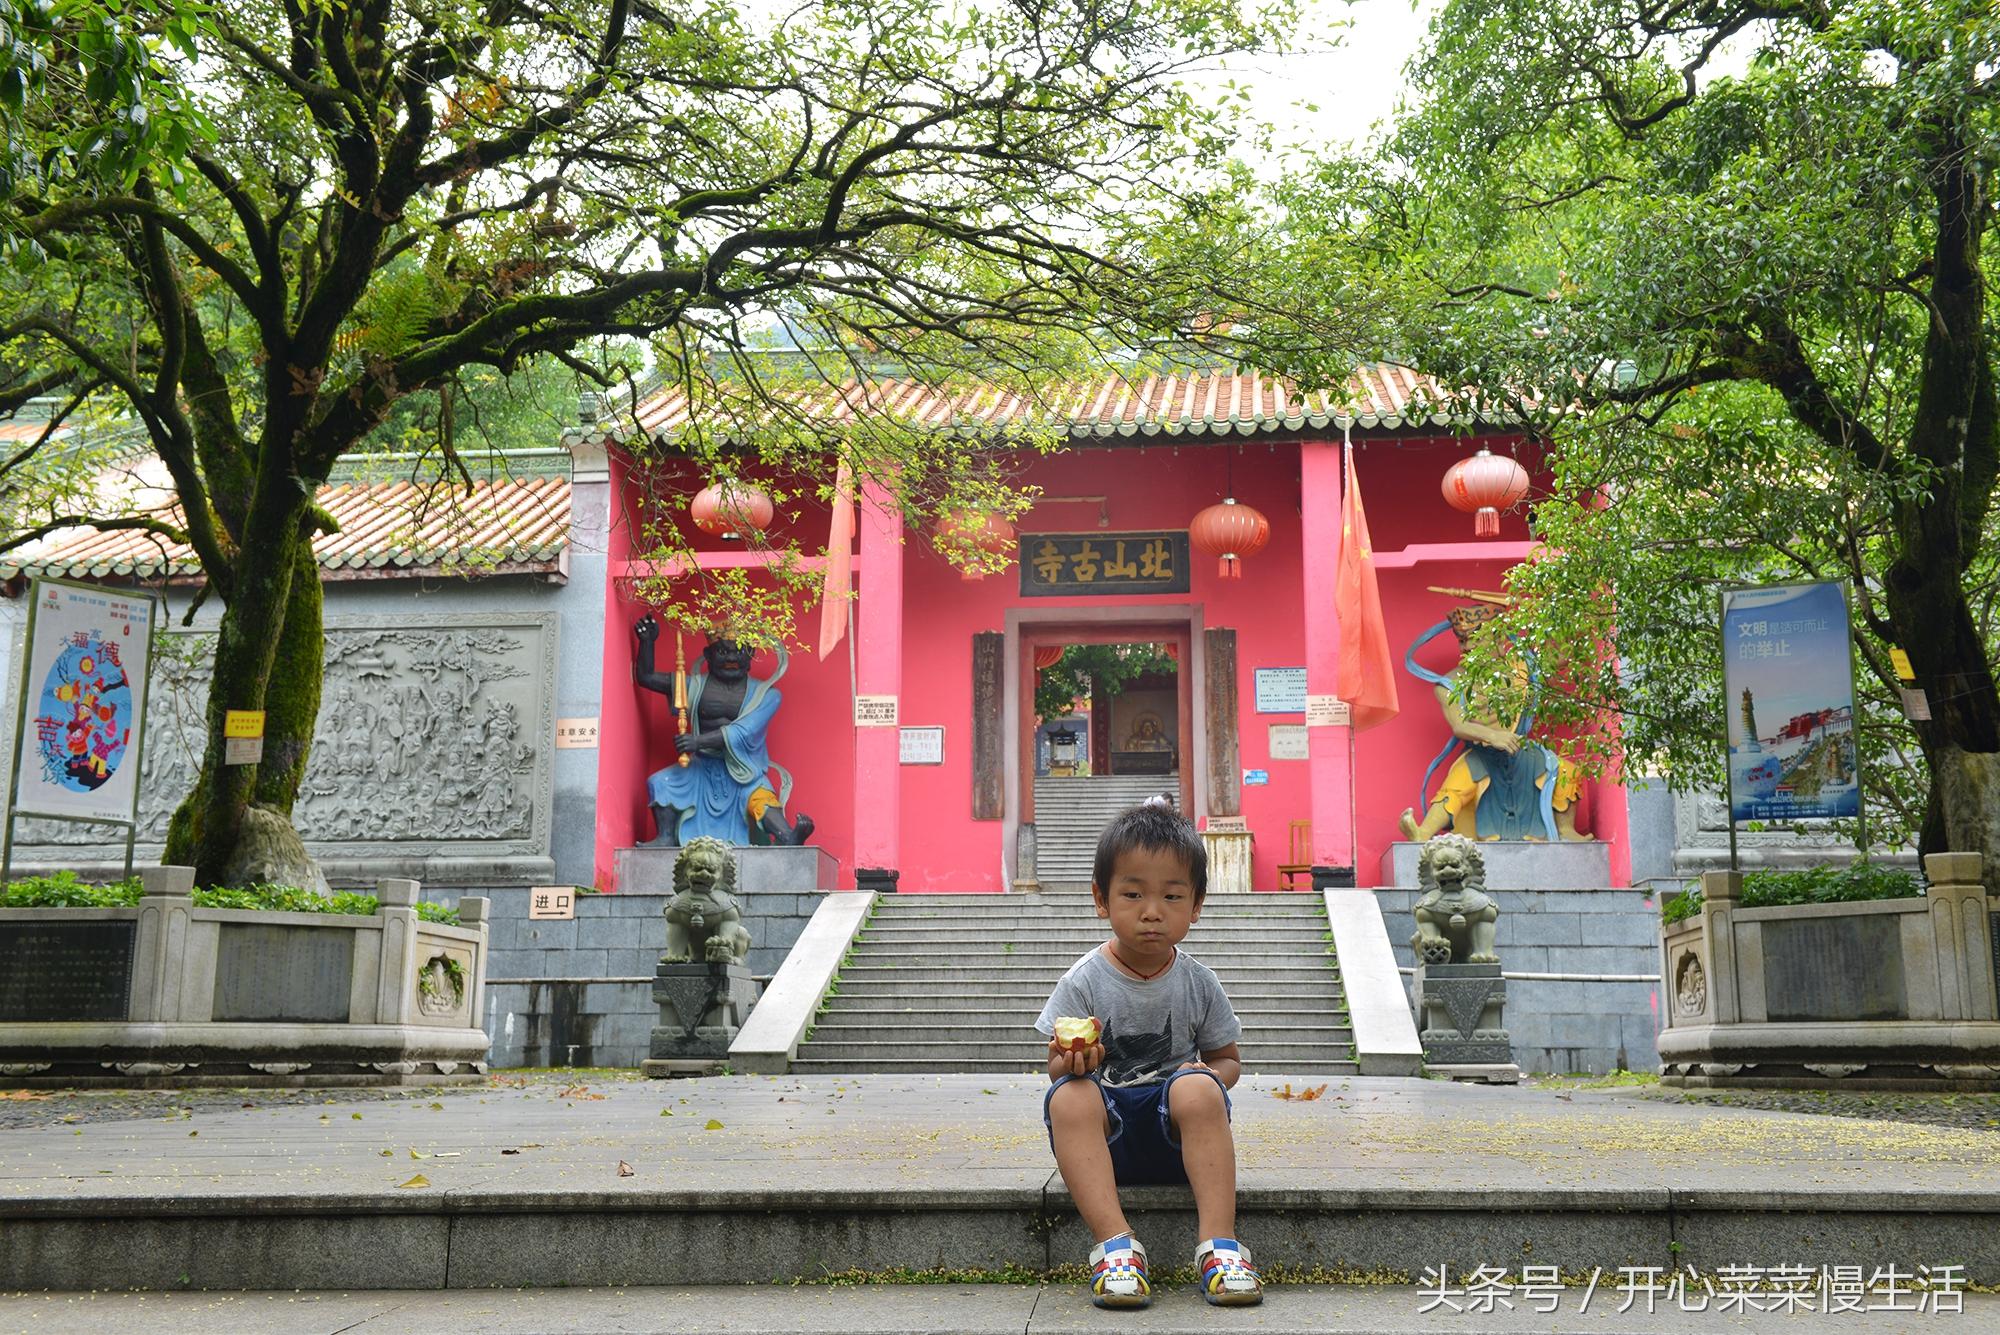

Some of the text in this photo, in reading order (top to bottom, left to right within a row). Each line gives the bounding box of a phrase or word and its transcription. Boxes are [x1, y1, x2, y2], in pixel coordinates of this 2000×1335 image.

[557, 727, 598, 737] 注意安全
[536, 894, 569, 908] 进口
